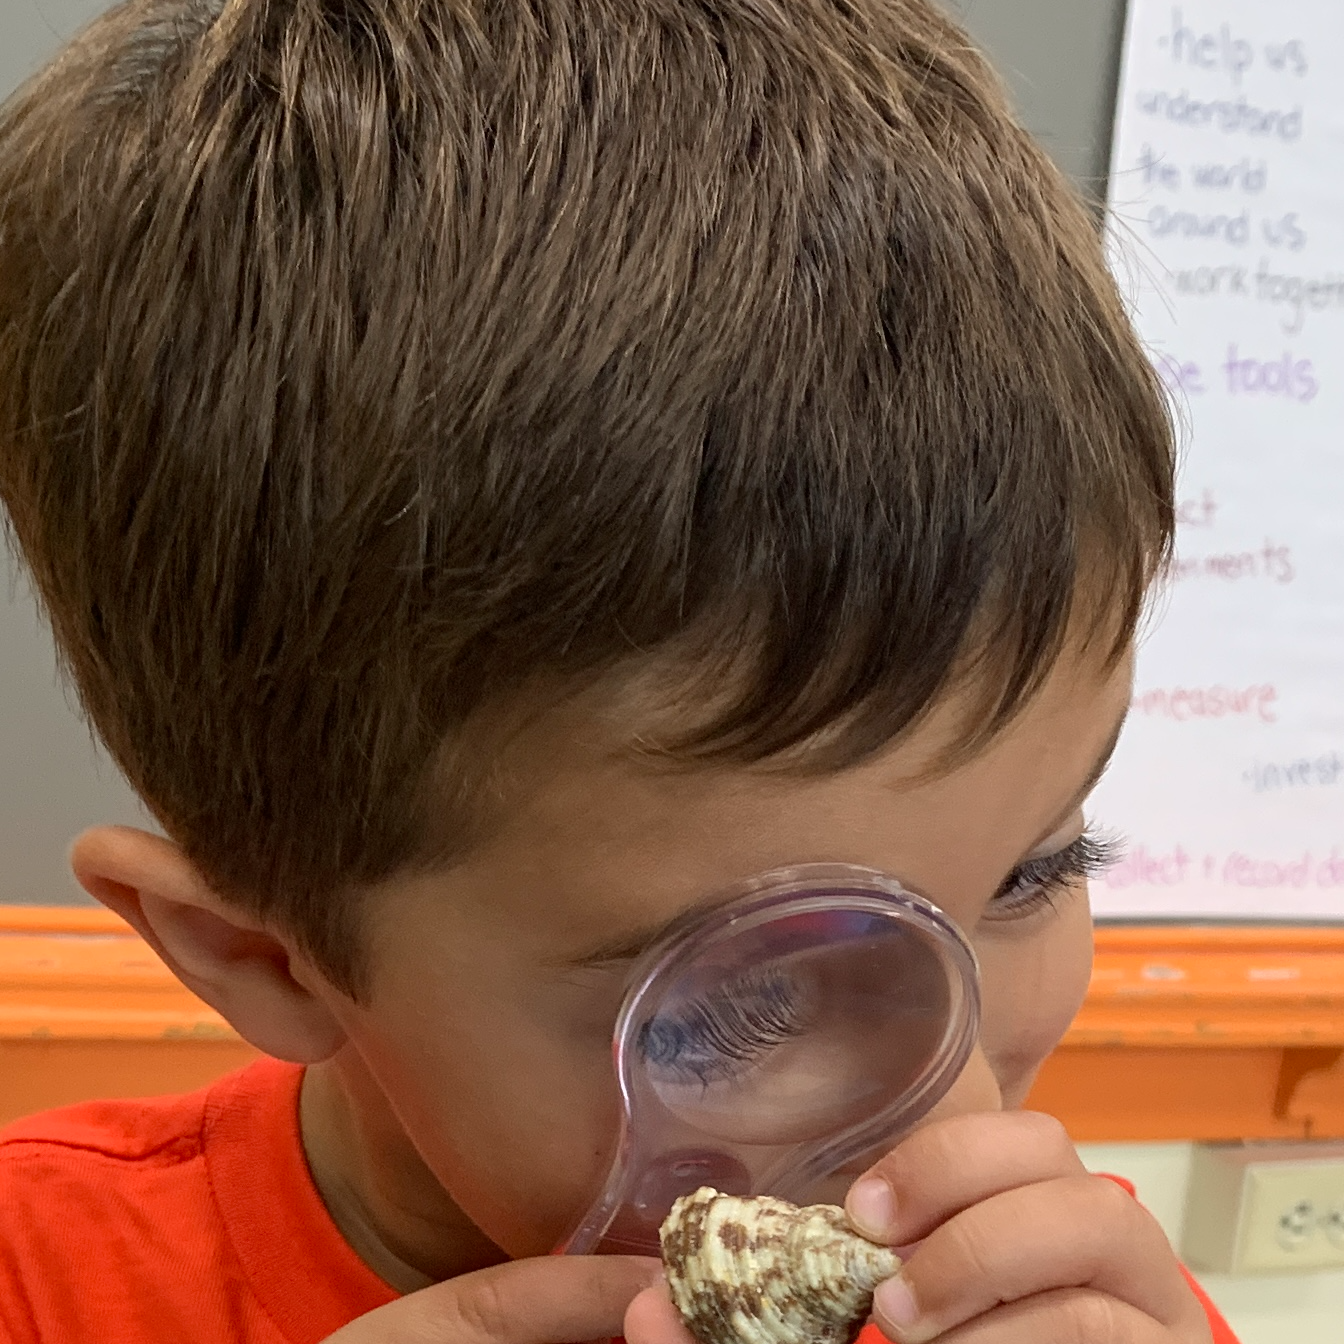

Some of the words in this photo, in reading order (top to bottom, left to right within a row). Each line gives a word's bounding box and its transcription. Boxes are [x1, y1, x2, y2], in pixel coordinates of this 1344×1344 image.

[1171, 6, 1254, 83] help
[1264, 38, 1308, 76] us
[1262, 211, 1307, 251] us
[1223, 340, 1320, 402] tools
